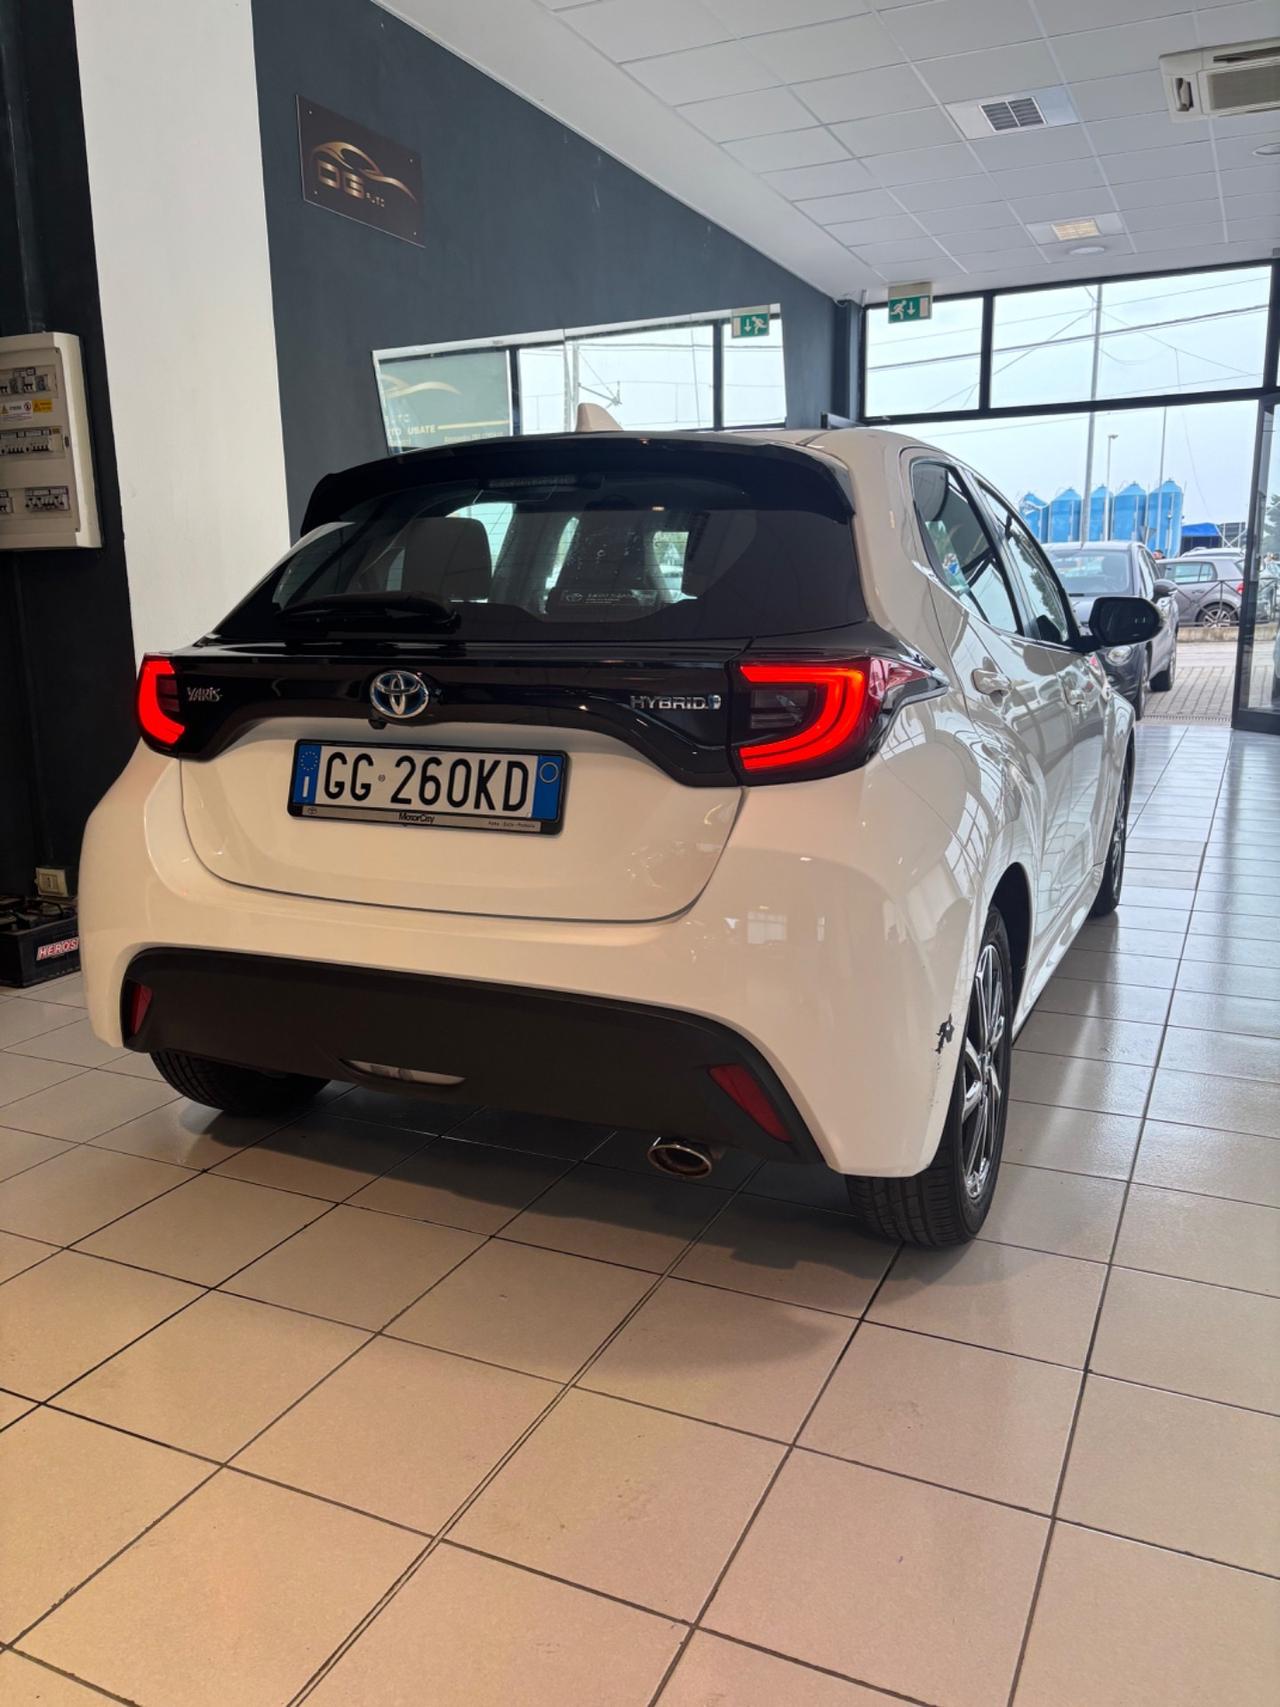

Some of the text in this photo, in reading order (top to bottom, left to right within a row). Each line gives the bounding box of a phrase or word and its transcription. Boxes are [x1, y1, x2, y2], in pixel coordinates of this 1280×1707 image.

[630, 695, 707, 710] HYBRID
[324, 752, 374, 802] GG
[390, 755, 529, 812] 260KD
